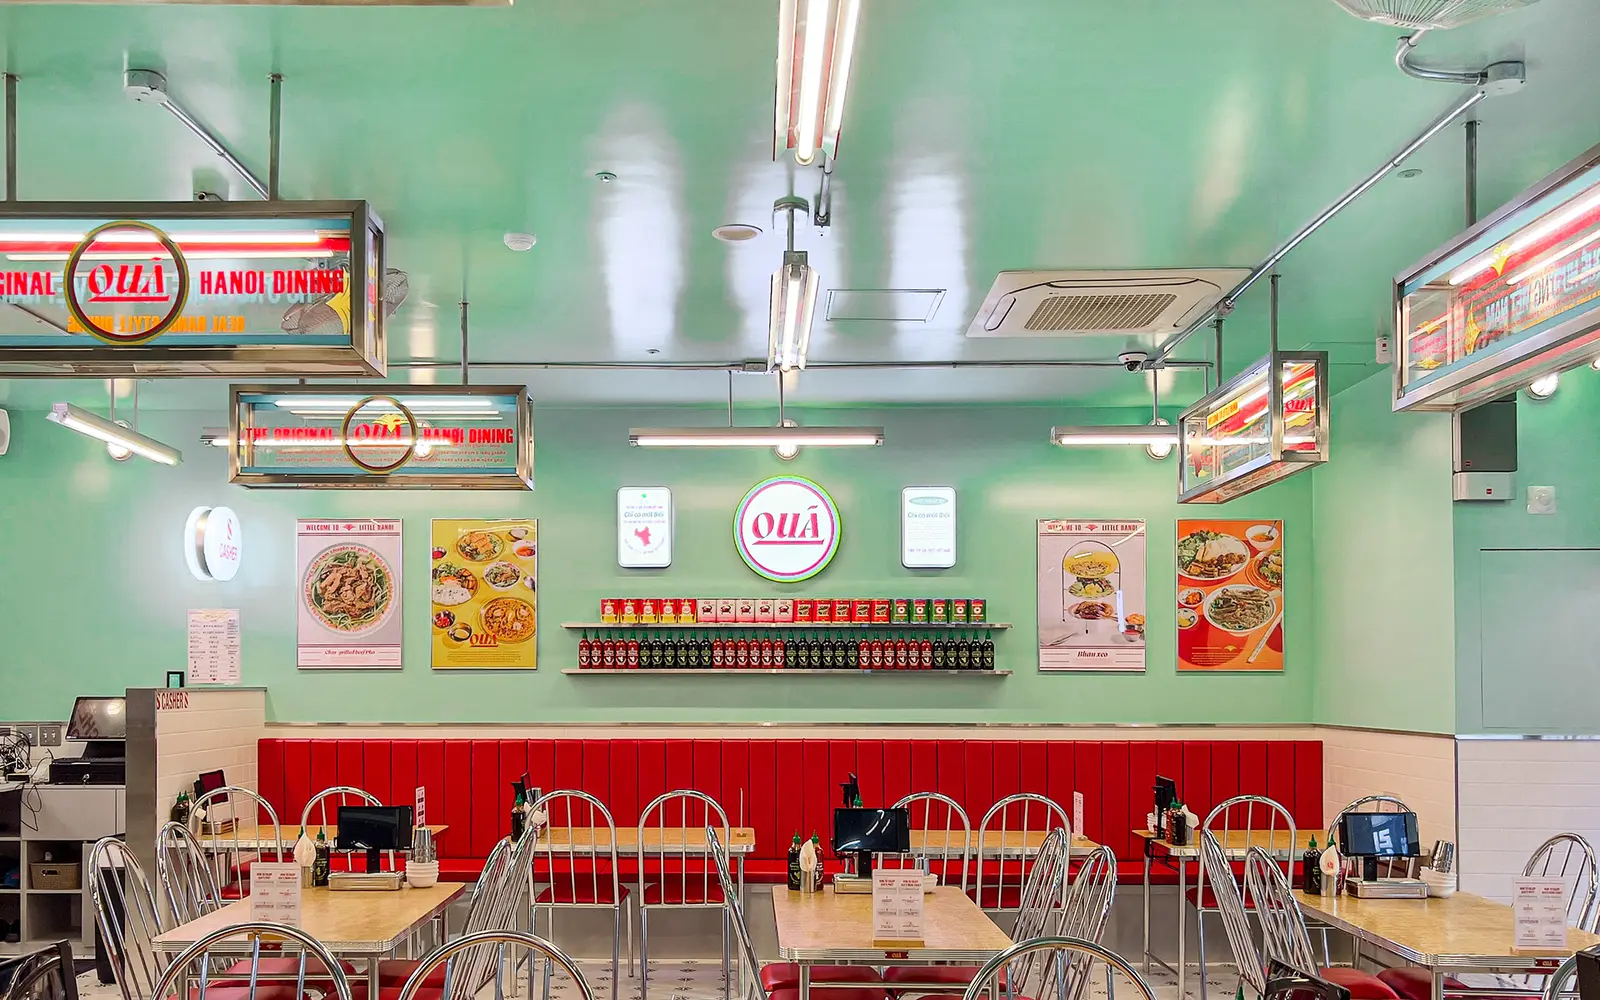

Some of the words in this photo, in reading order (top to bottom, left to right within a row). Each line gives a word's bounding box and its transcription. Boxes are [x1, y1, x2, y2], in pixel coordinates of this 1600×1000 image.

[200, 271, 264, 295] HANOI
[273, 270, 344, 294] DINING
[423, 427, 464, 443] HANOI
[469, 428, 514, 443] DINING
[162, 691, 184, 710] CASHER
